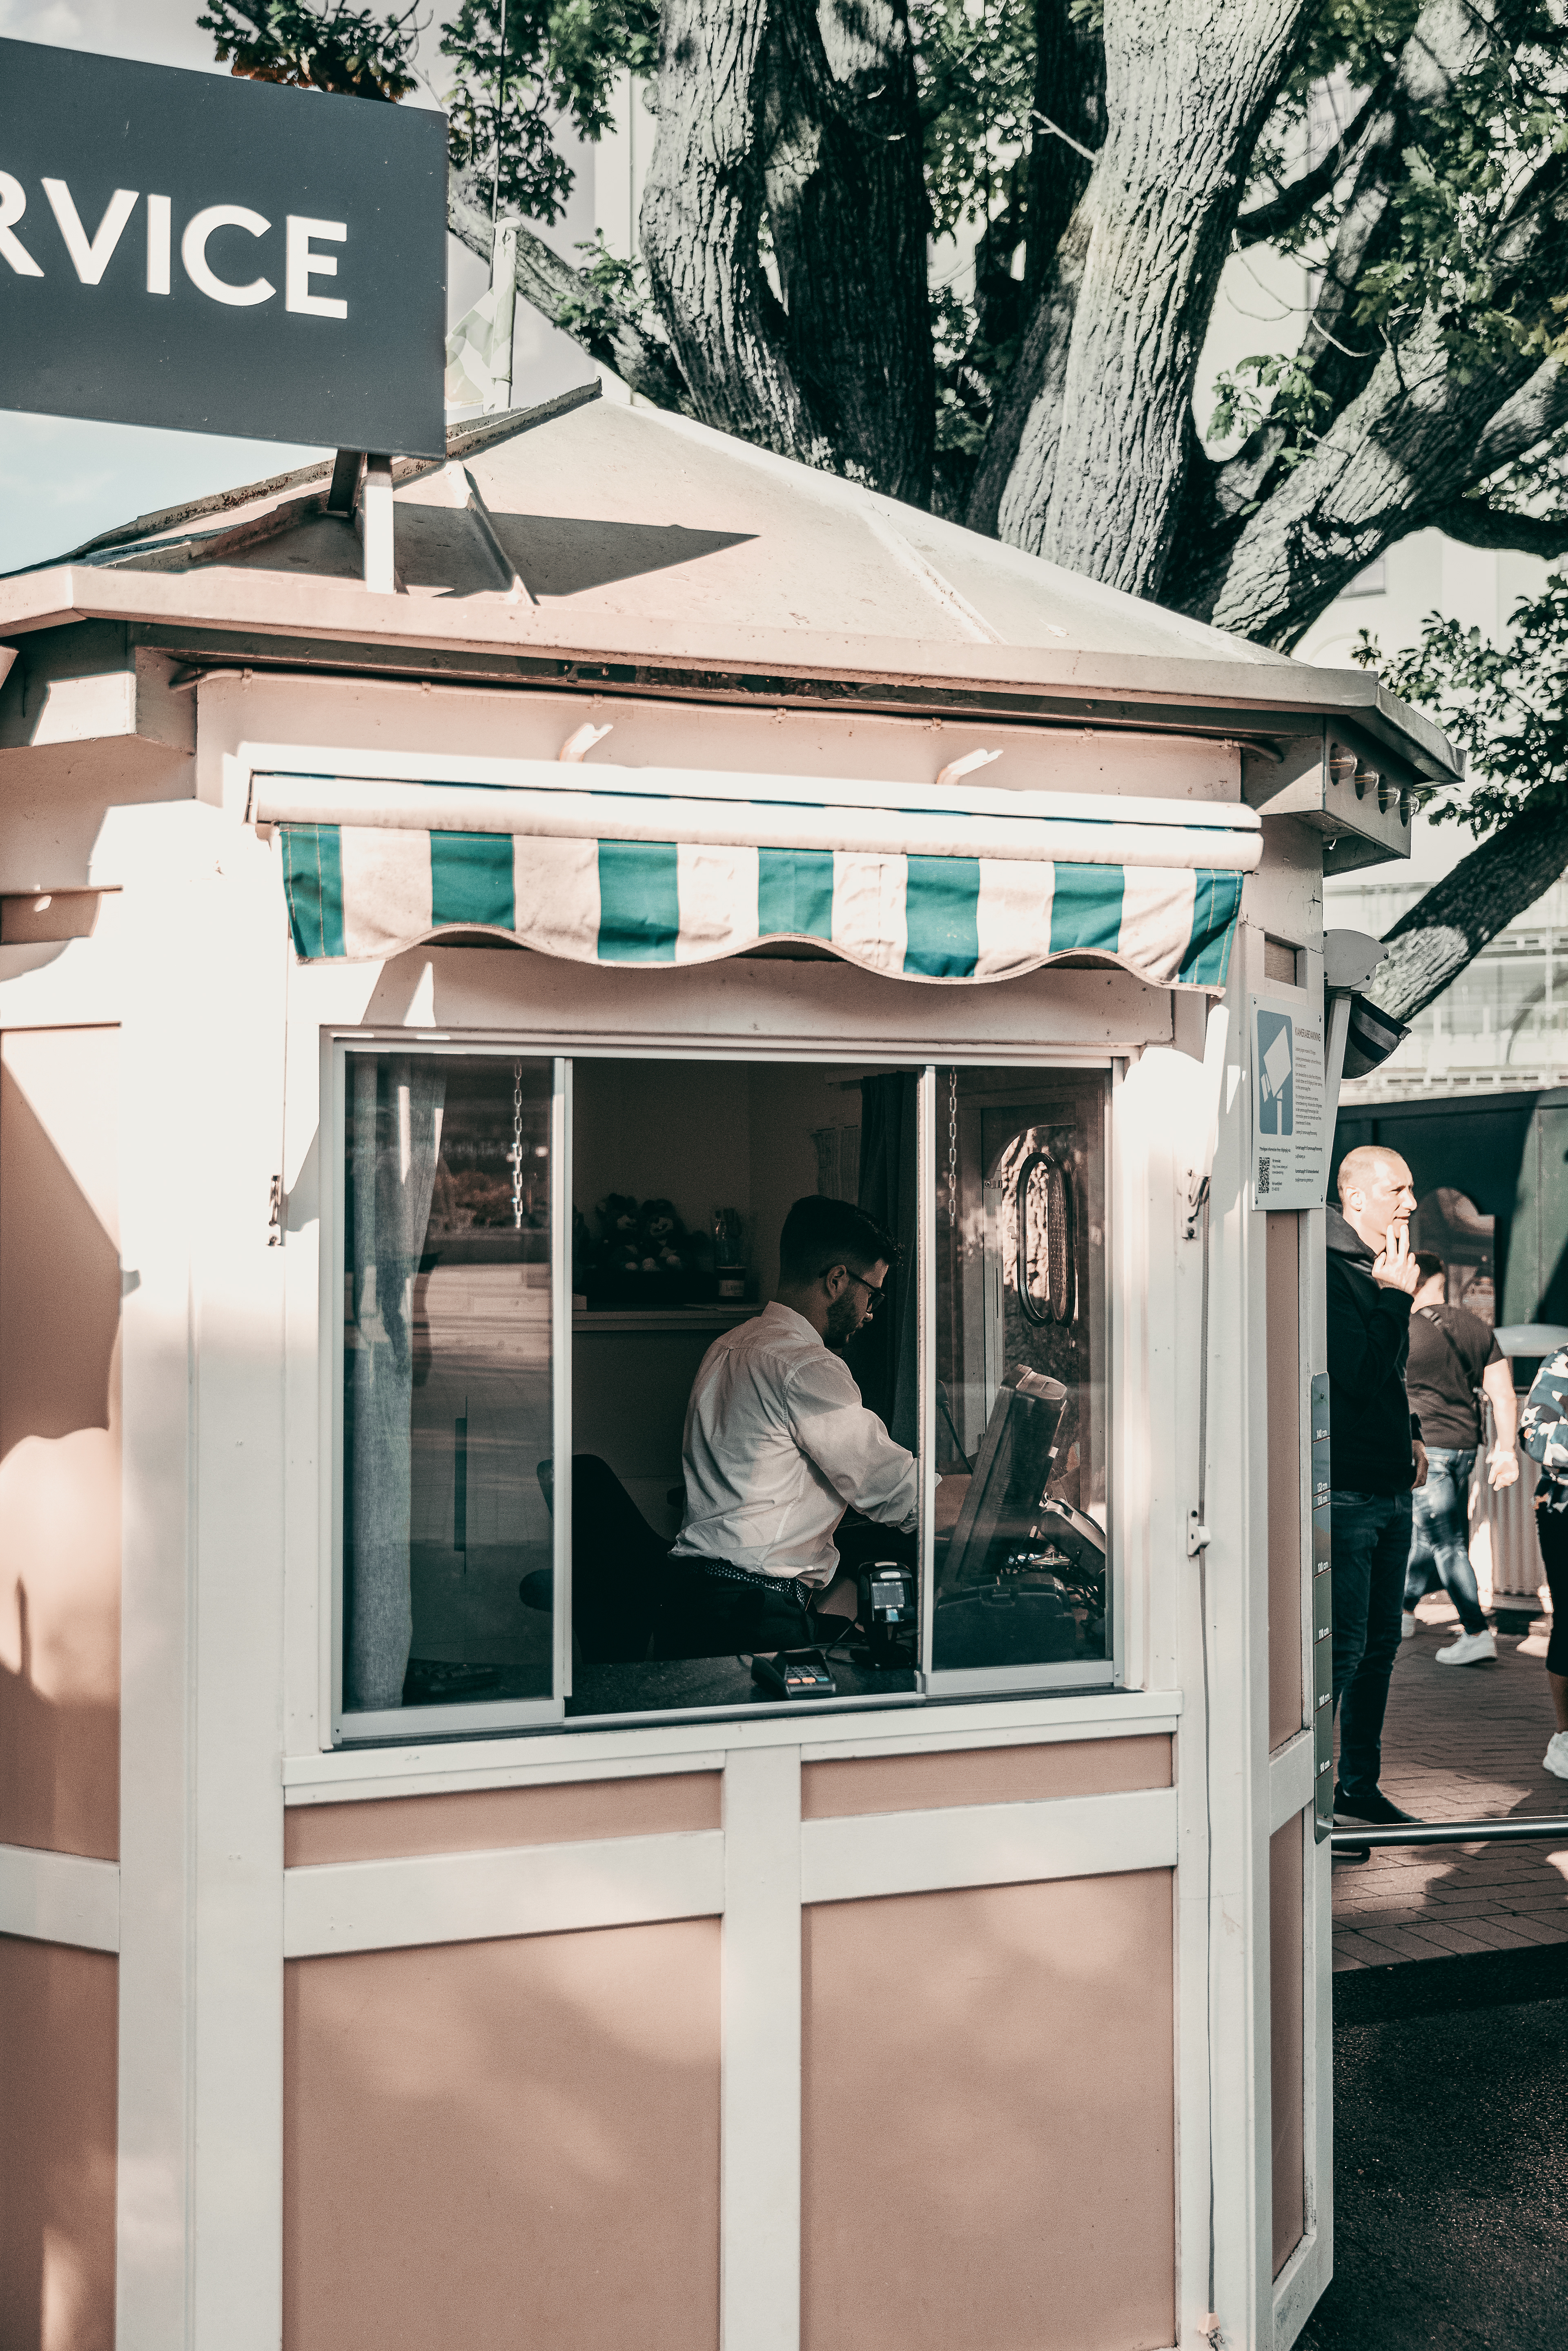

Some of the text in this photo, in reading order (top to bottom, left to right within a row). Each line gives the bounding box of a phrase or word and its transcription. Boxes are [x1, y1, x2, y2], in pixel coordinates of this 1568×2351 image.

[1295, 1027, 1321, 1042] KAMERABEVAKNING
[1323, 1482, 1327, 1490] cm
[1323, 1495, 1327, 1504] cm
[1323, 1561, 1328, 1570] cm
[1324, 1627, 1329, 1636] cm
[1325, 1693, 1330, 1702] cm
[1320, 1760, 1330, 1773] 90 cm
